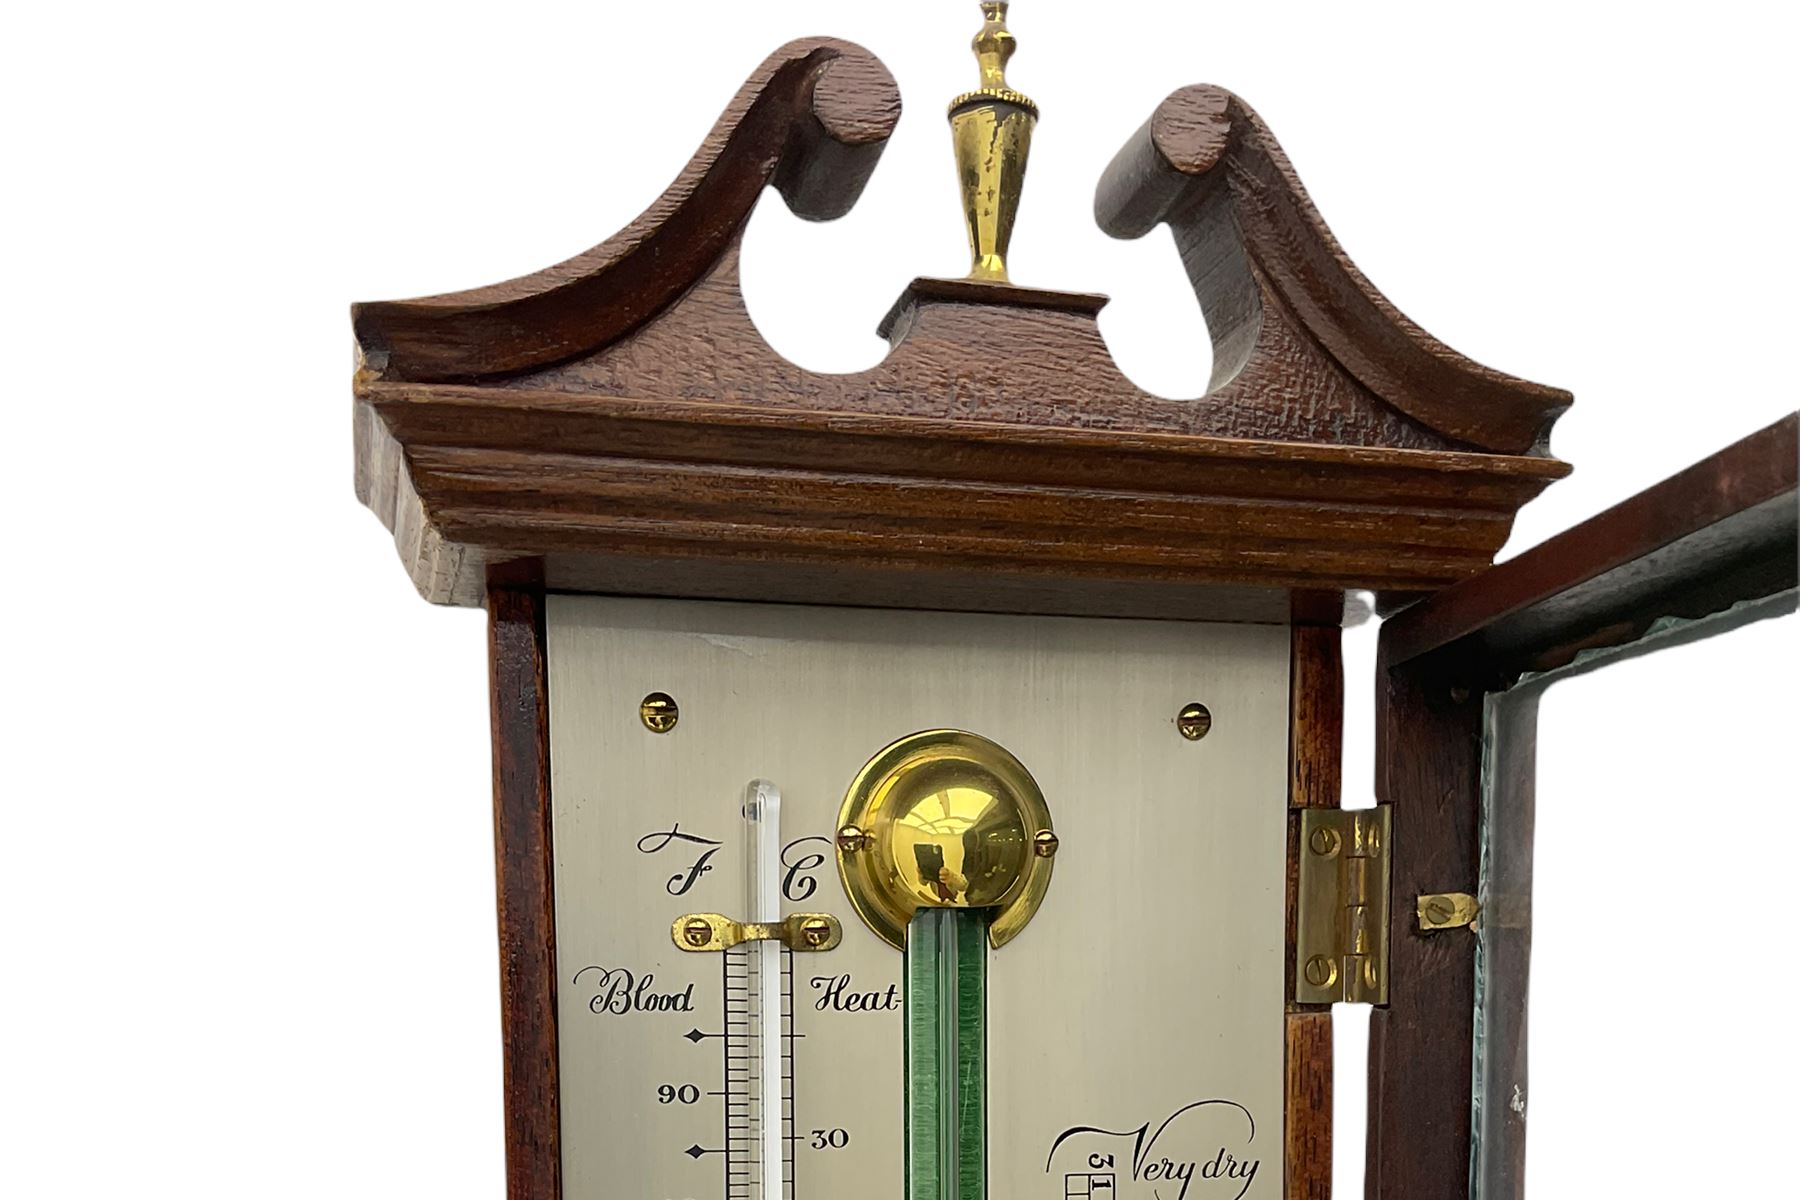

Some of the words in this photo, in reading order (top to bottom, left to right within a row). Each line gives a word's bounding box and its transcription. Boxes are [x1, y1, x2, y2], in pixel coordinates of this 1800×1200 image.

[780, 836, 832, 901] C
[573, 966, 695, 1015] Blood
[657, 1083, 700, 1105] 90
[811, 1128, 849, 1149] 30
